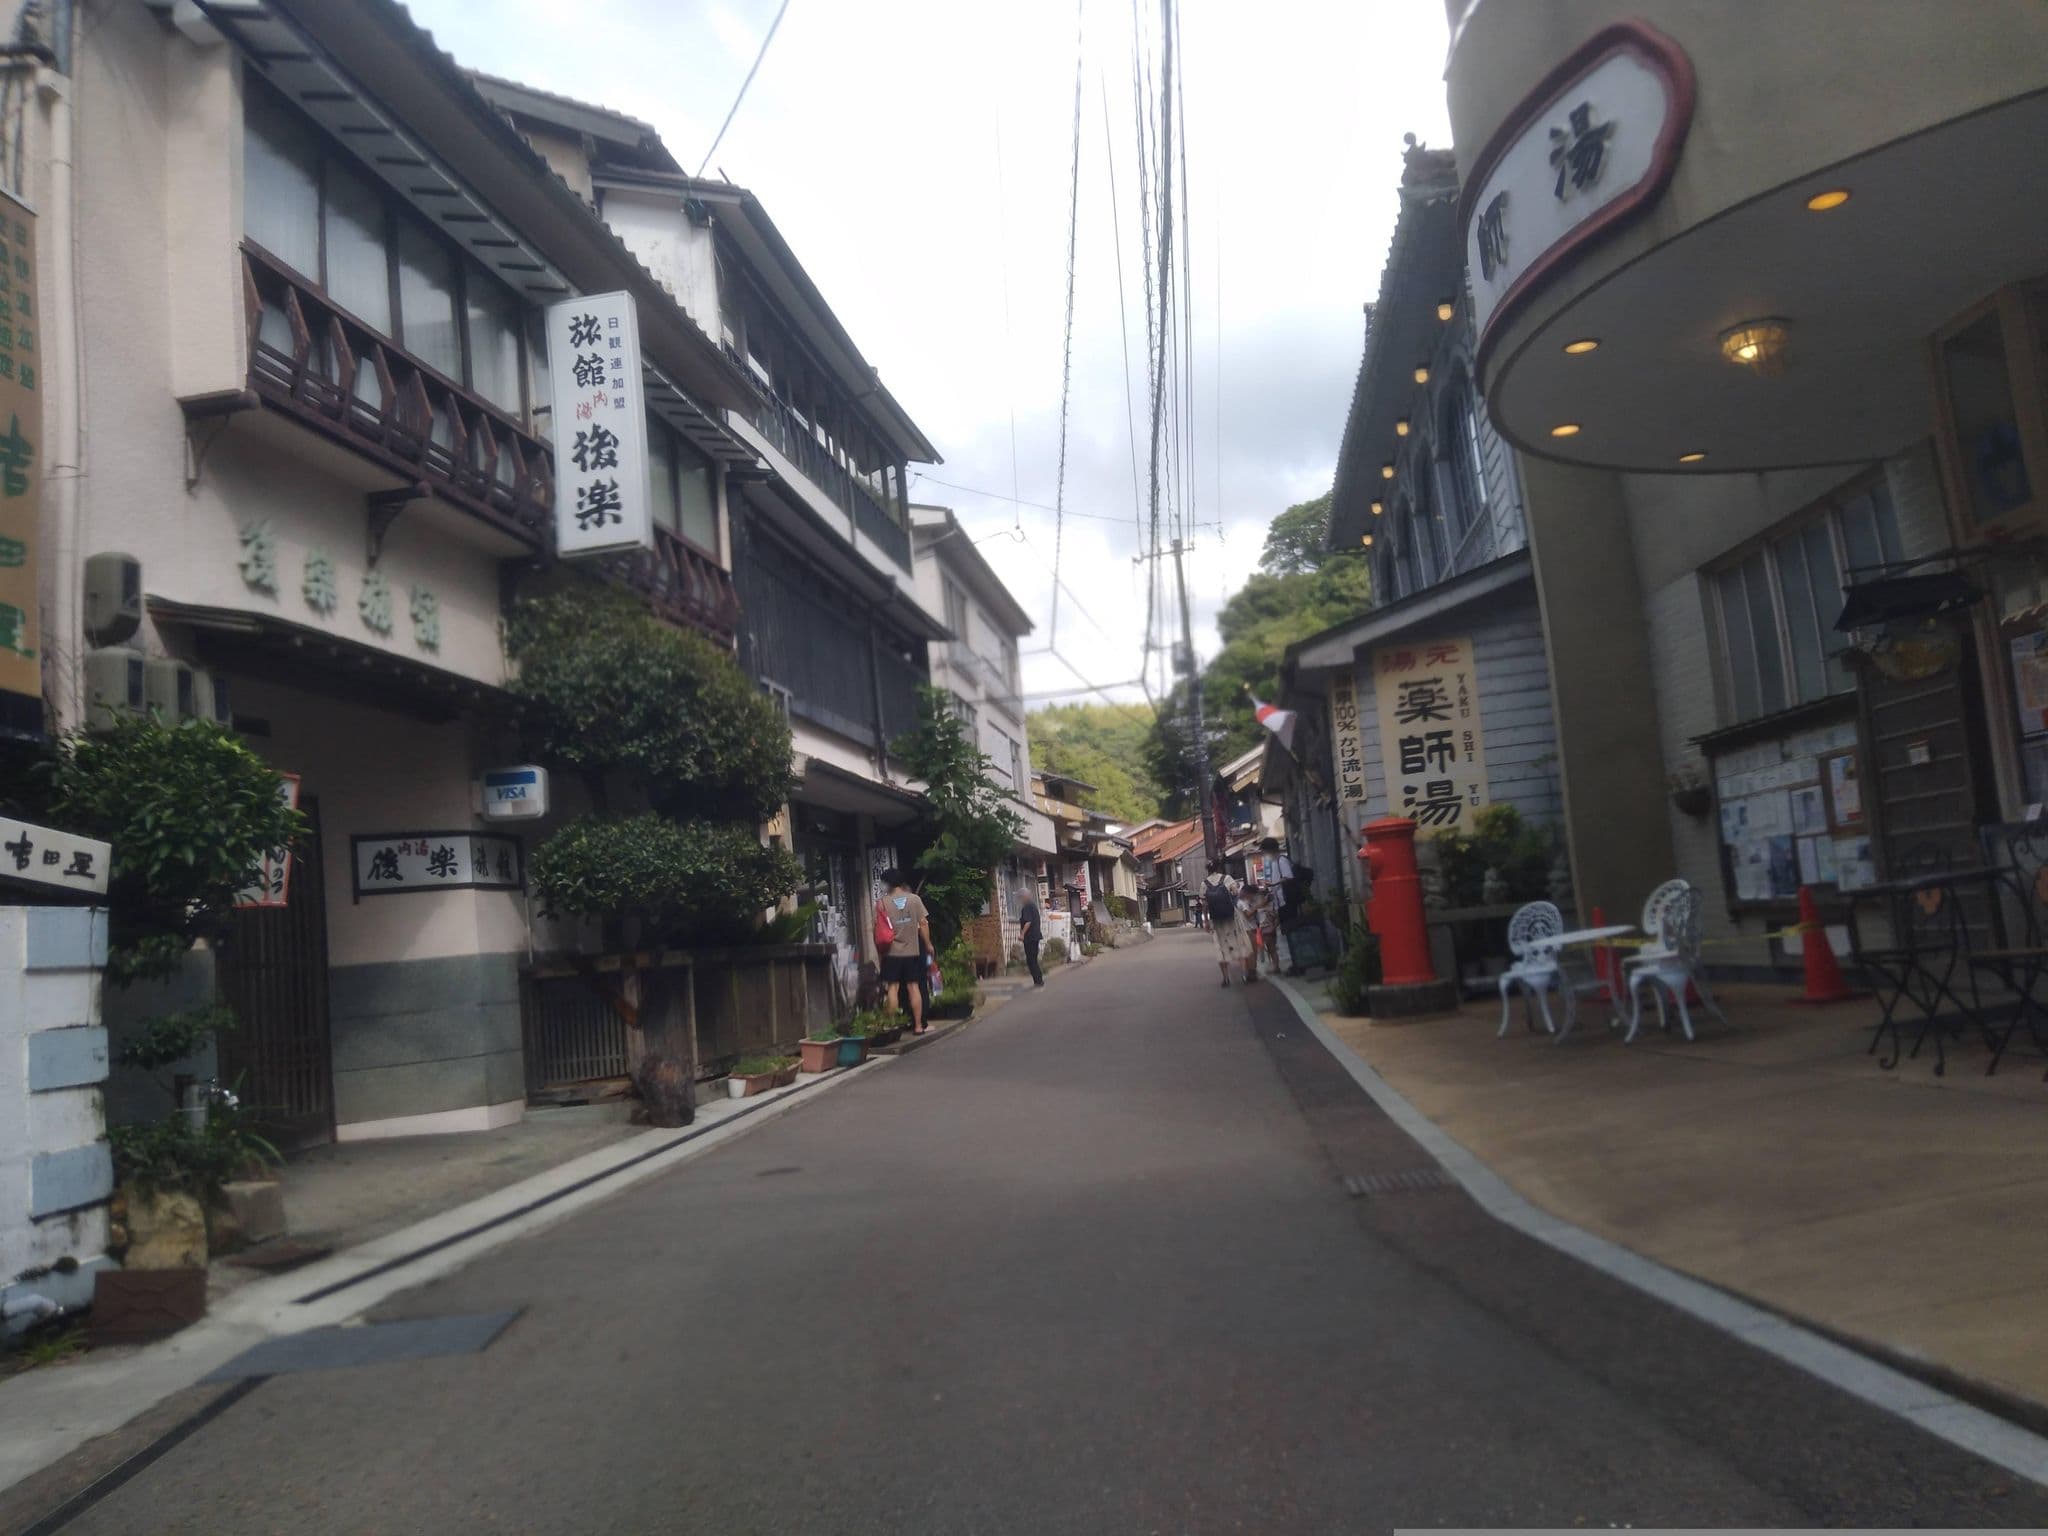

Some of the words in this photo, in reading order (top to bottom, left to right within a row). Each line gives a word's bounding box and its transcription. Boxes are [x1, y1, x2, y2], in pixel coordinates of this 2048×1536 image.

[568, 313, 607, 389] 旅館
[608, 316, 626, 410] 日観連加盟
[1394, 677, 1464, 827] 薬師湯
[496, 786, 527, 800] VISA
[5, 830, 97, 880] 吉田屋
